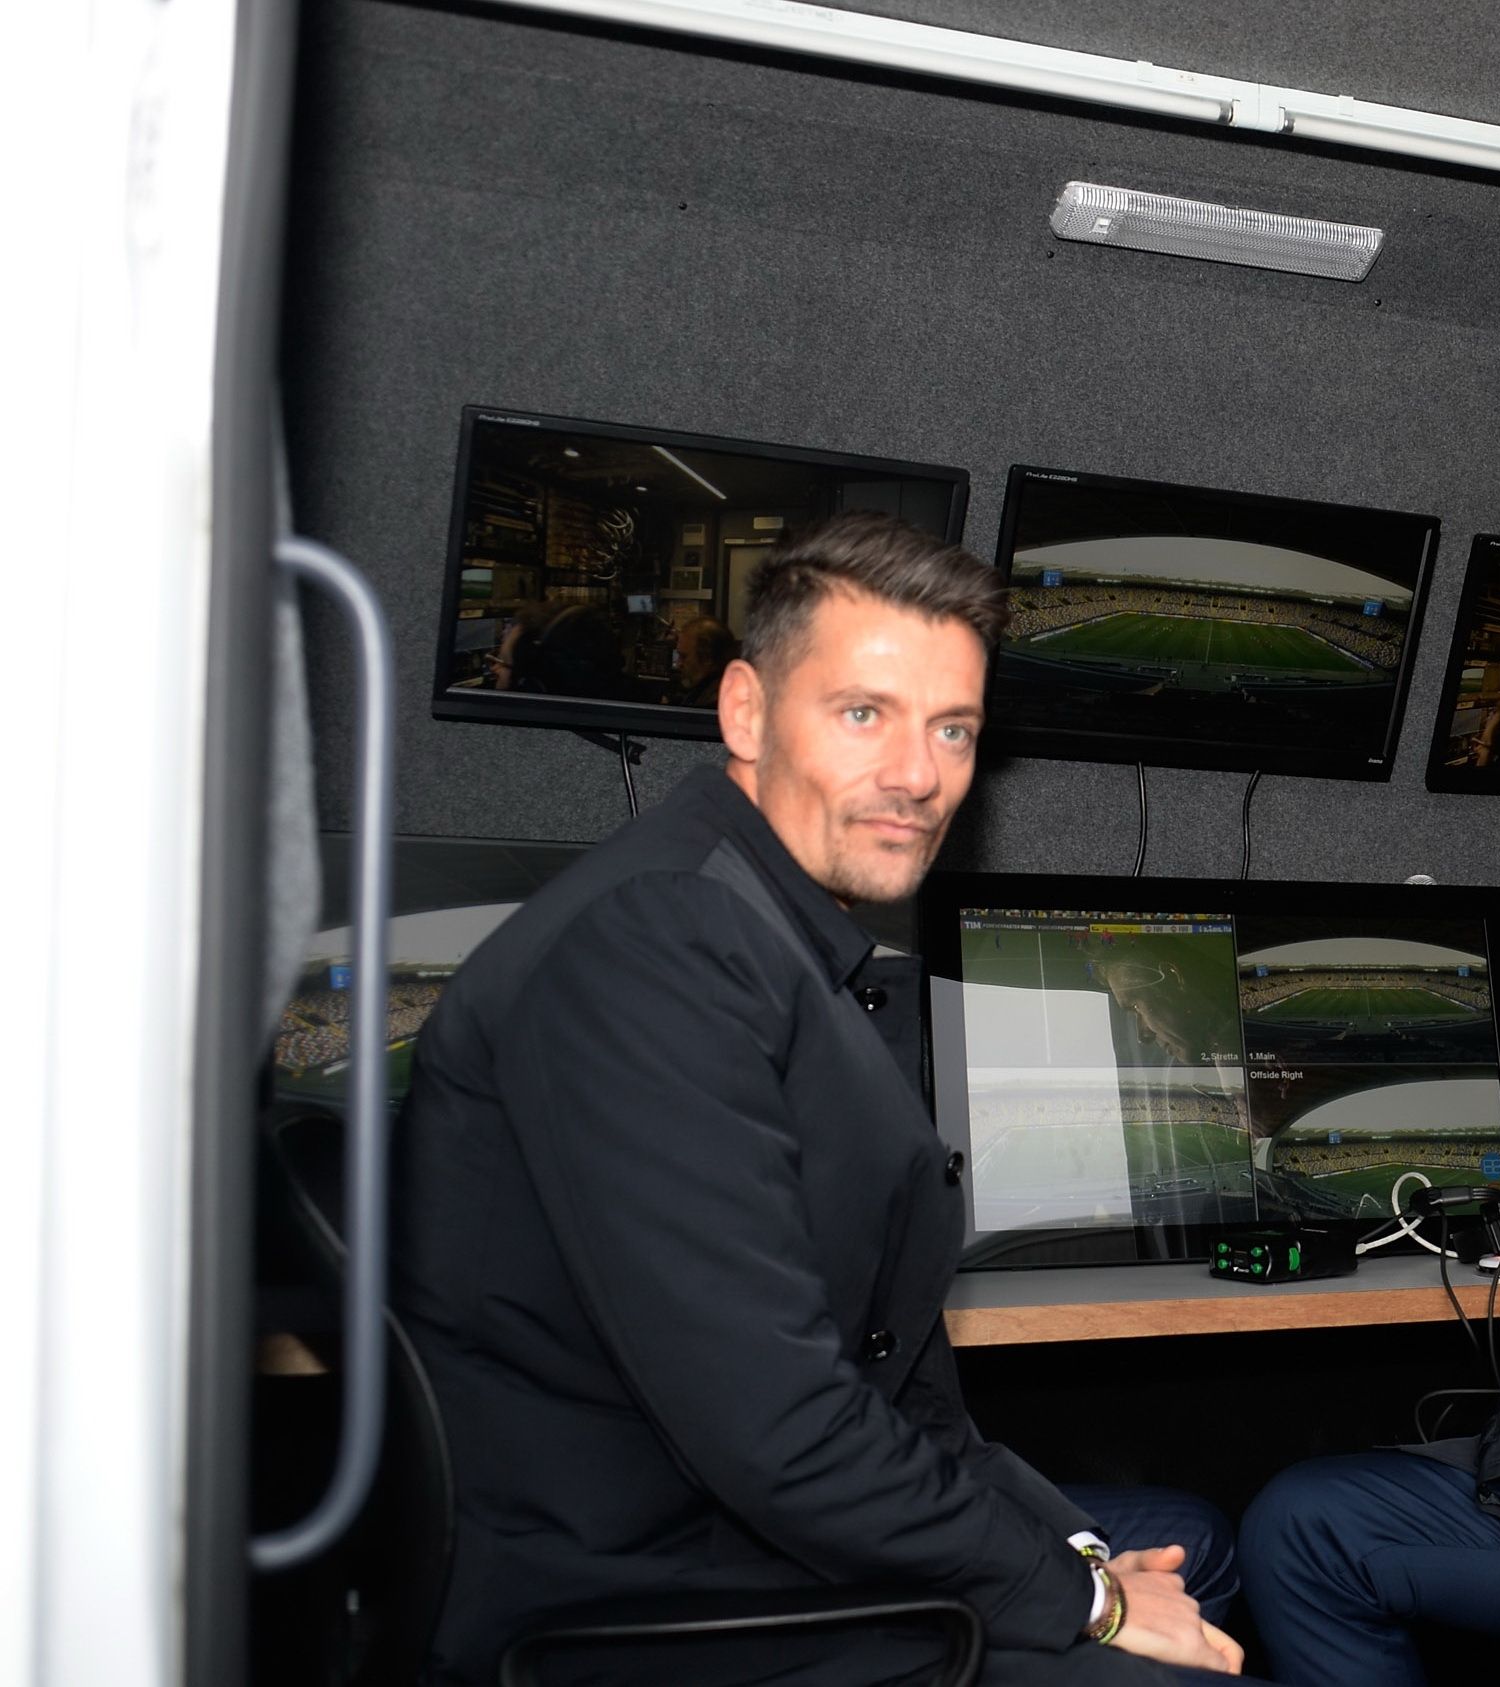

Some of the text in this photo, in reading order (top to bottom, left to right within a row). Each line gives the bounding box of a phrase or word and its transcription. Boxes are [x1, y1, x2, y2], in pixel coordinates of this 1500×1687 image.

[1210, 1052, 1239, 1061] Stretta
[1249, 1071, 1304, 1081] Offside Right
